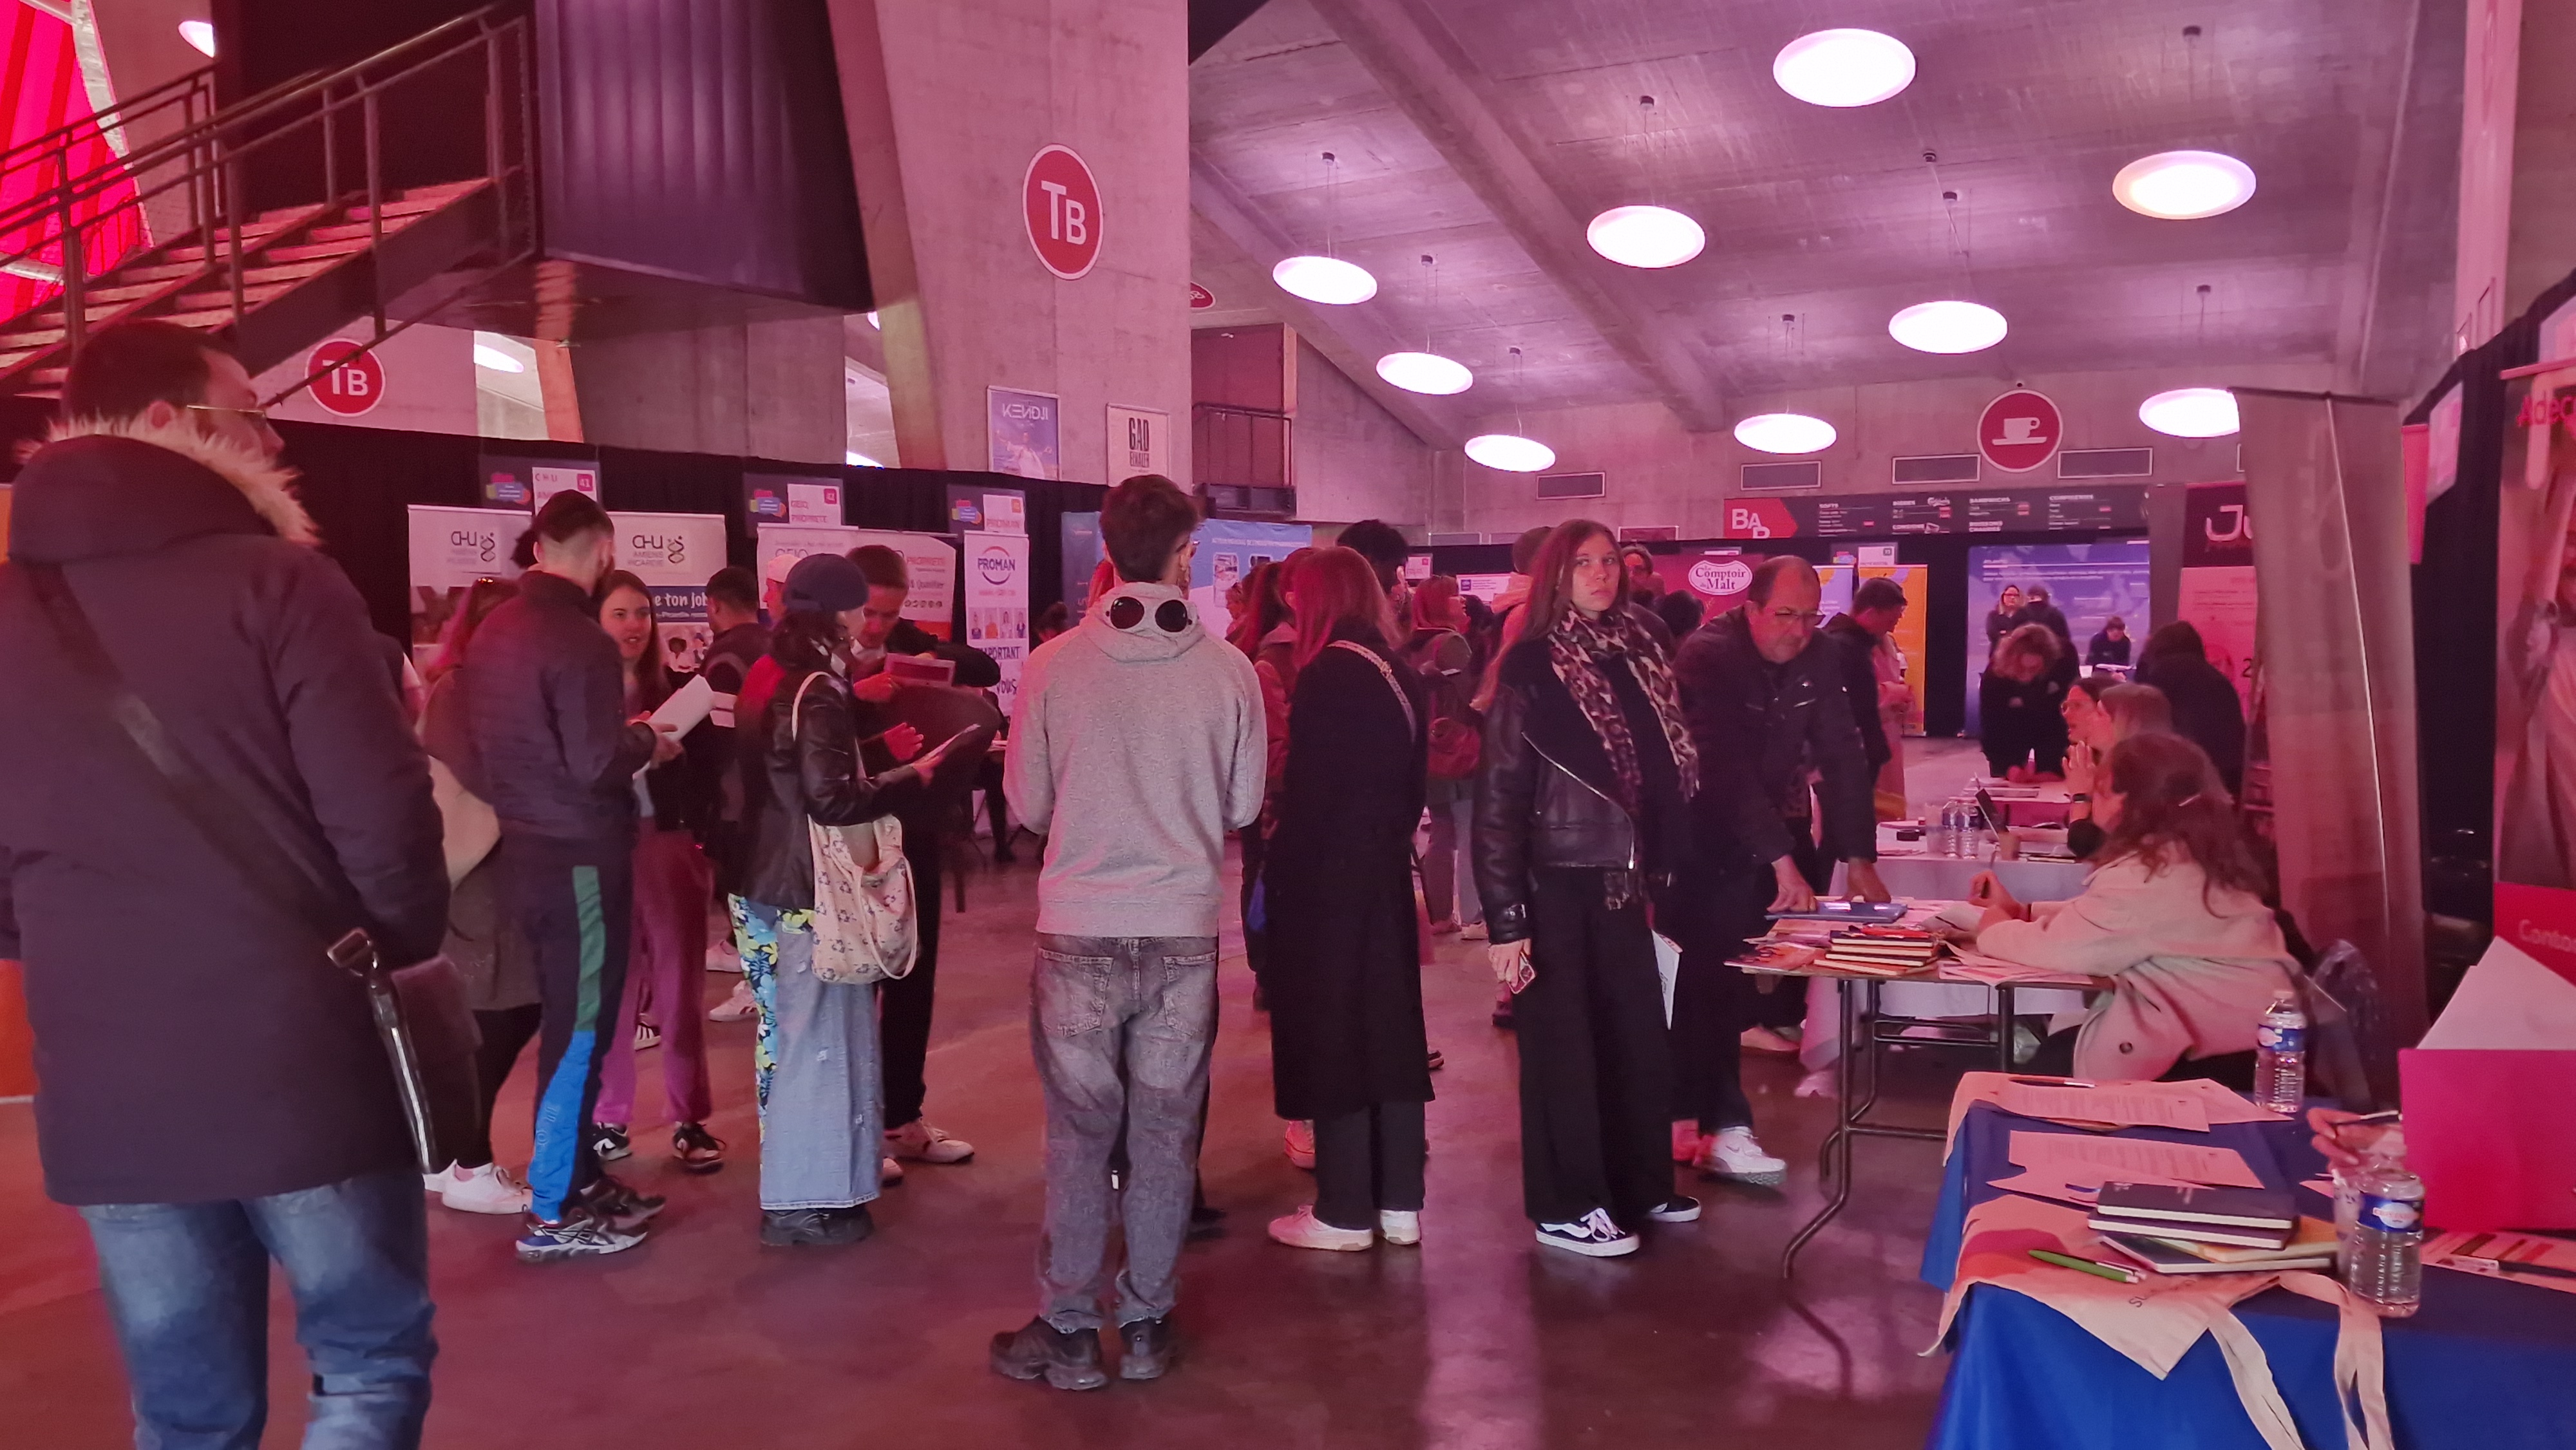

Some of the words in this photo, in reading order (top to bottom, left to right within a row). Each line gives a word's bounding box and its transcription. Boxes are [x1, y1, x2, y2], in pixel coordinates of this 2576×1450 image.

[1041, 180, 1087, 245] TB
[322, 359, 369, 397] TB
[1128, 417, 1150, 452] GAD
[451, 531, 478, 546] CHU
[632, 534, 664, 549] CHU
[977, 558, 1016, 571] PROMAN
[1695, 567, 1747, 581] Comptoir
[1707, 578, 1736, 589] Malt
[665, 593, 688, 607] ton
